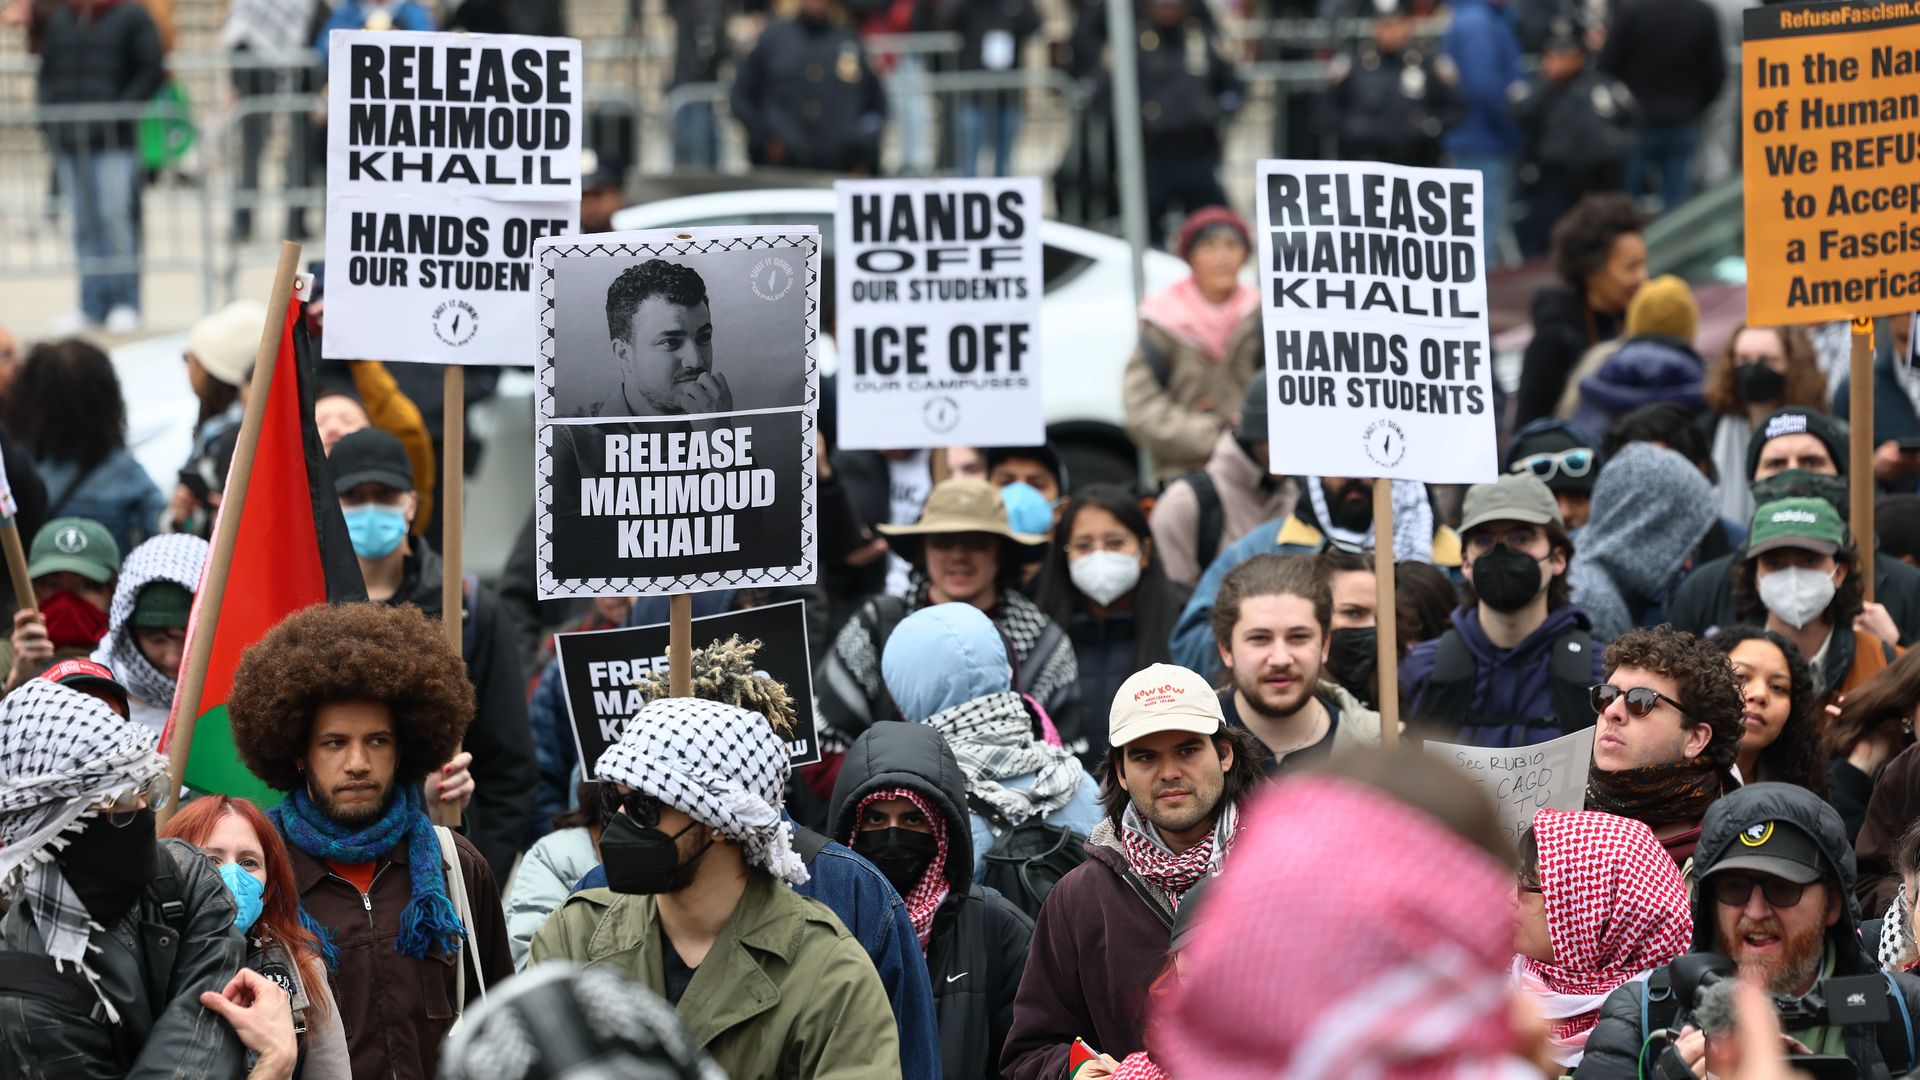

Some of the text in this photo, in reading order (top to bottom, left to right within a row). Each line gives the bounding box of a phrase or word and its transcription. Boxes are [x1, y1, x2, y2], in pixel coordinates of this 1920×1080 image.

[351, 44, 572, 104] RELEASE
[1758, 45, 1920, 88] In the Na
[349, 104, 571, 150] MAHMOUD
[1753, 101, 1788, 133] of
[349, 151, 571, 185] KHALIL
[1765, 131, 1920, 177] We REFU
[852, 190, 1025, 243] HANDS
[1267, 173, 1476, 237] RELEASE
[1782, 189, 1817, 219] to
[351, 211, 490, 258] HANDS
[1786, 238, 1806, 263] a
[349, 256, 534, 292] OUR STUDEN
[856, 246, 1023, 274] OFF
[1271, 231, 1476, 284] MAHMOUD
[852, 276, 1029, 303] OUR STUDENTS
[1273, 277, 1480, 319] KHALIL
[854, 323, 1029, 375] ICE OFF
[1276, 330, 1481, 381] HANDS OFF
[1278, 374, 1485, 415] OUR STUDENTS
[605, 426, 753, 473] RELEASE
[581, 468, 776, 517] MAHMOUD
[617, 514, 740, 558] KHALIL
[1456, 752, 1545, 771] Sec RUBIO
[1496, 768, 1553, 800] CAGO
